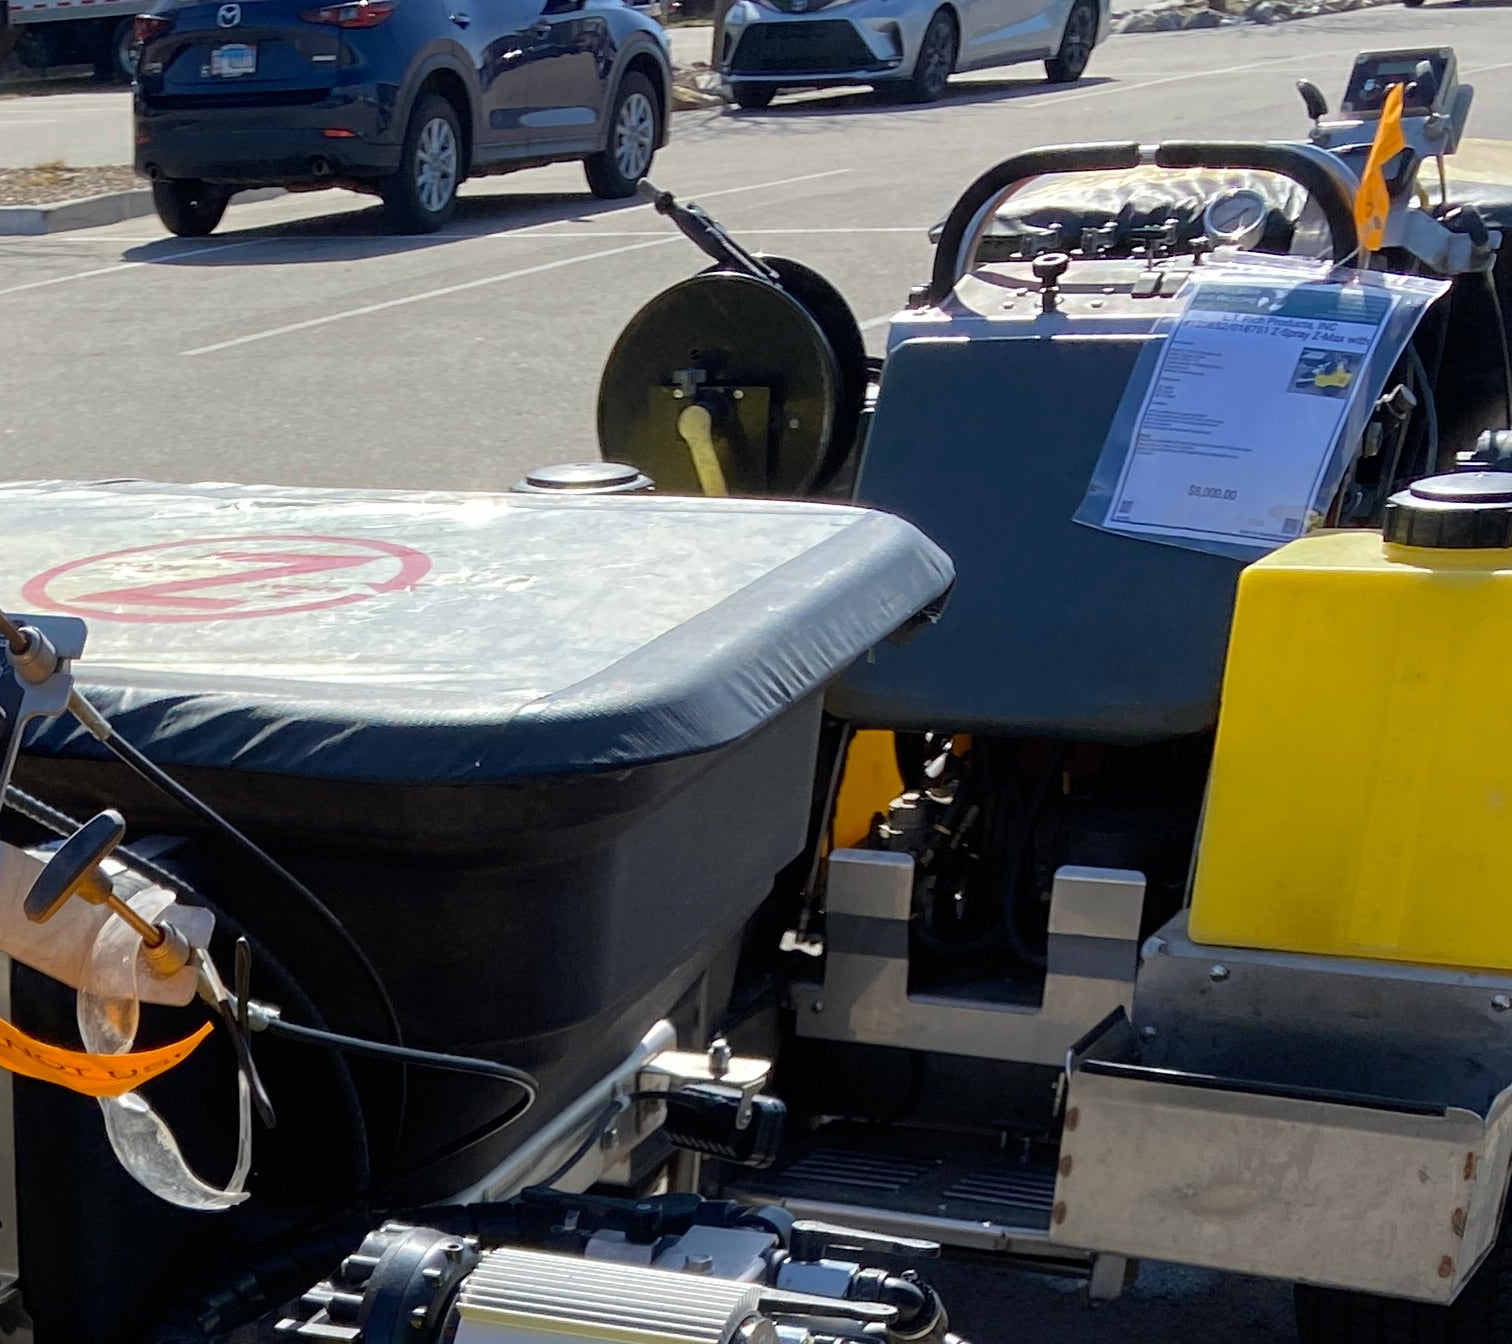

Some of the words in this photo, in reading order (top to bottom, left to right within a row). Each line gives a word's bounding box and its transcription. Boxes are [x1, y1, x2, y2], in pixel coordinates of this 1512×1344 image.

[1242, 315, 1266, 325] Rich
[1318, 321, 1339, 332] INC
[1270, 326, 1310, 341] Z-Spray
[1311, 330, 1345, 343] Z-Max
[1347, 336, 1372, 346] with
